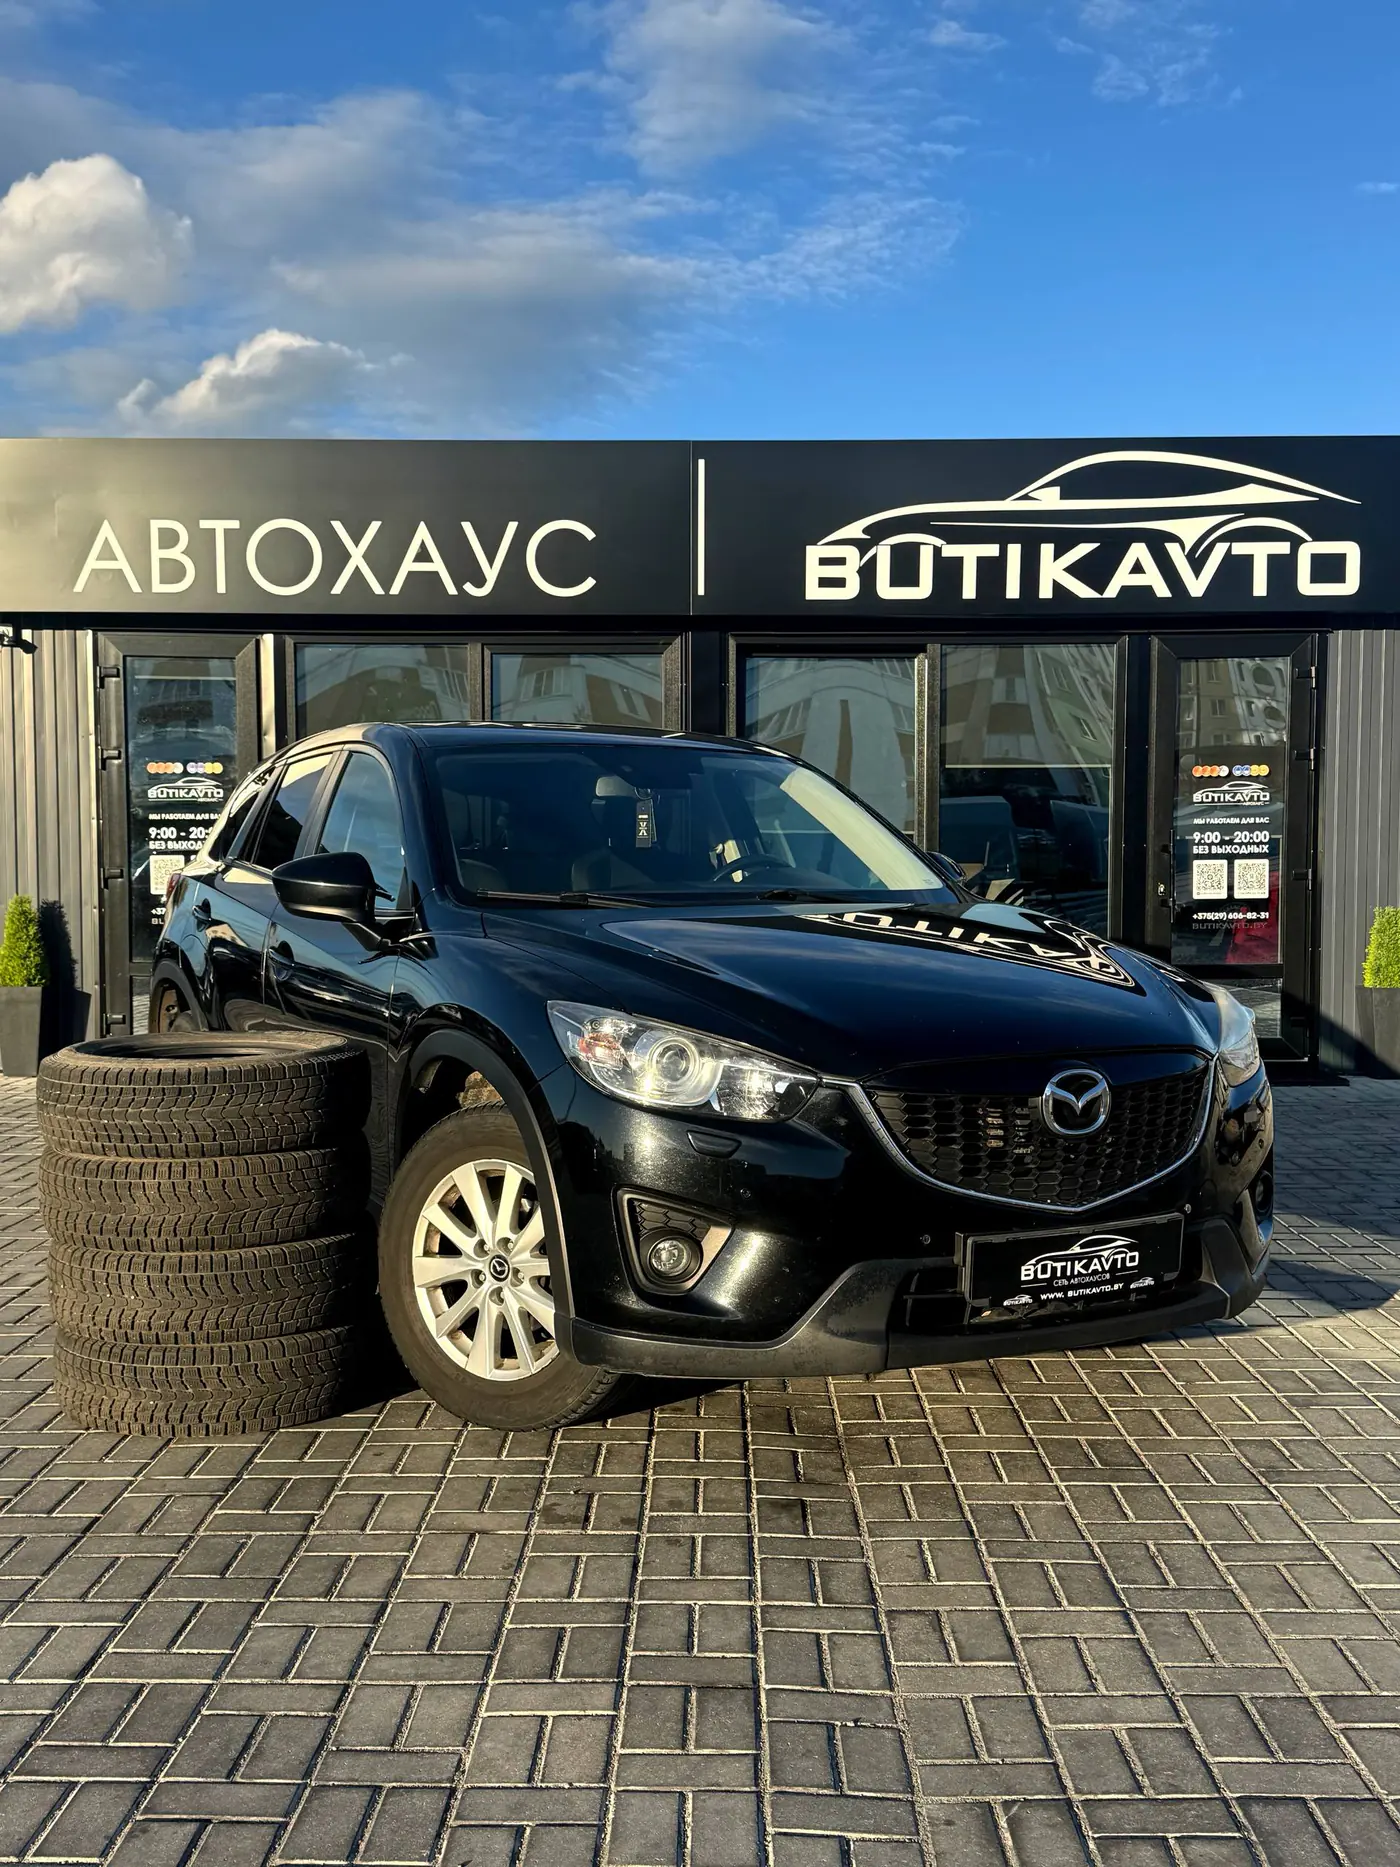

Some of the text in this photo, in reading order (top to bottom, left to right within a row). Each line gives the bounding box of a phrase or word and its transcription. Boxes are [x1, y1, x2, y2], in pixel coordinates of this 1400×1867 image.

[73, 518, 597, 598] АВТОХАУС
[805, 540, 1361, 600] BUTIKAVTO
[148, 788, 224, 798] BUTIKAVTO
[1193, 791, 1270, 803] BUTIKAVTO
[1206, 817, 1240, 825] РАБОТАЕМ
[1240, 817, 1255, 825] ДЛЯ
[148, 826, 177, 839] 9:00
[189, 826, 213, 839] 20:
[1193, 831, 1221, 844] 9:00
[1233, 830, 1270, 843] 20:00
[149, 841, 205, 851] БЕЗ ВЫХОД
[1193, 844, 1269, 854] БЕЗ ВЫХОДНЫХ
[1192, 912, 1227, 920] +375(29)
[1192, 921, 1268, 930] BUTIKAVTO.BY
[1021, 1251, 1139, 1281] BUTIKAVTO
[1053, 1272, 1111, 1287] СЕТЬ АВТОХАУСОВ
[1067, 1283, 1125, 1297] BUTIKAVTO.BY
